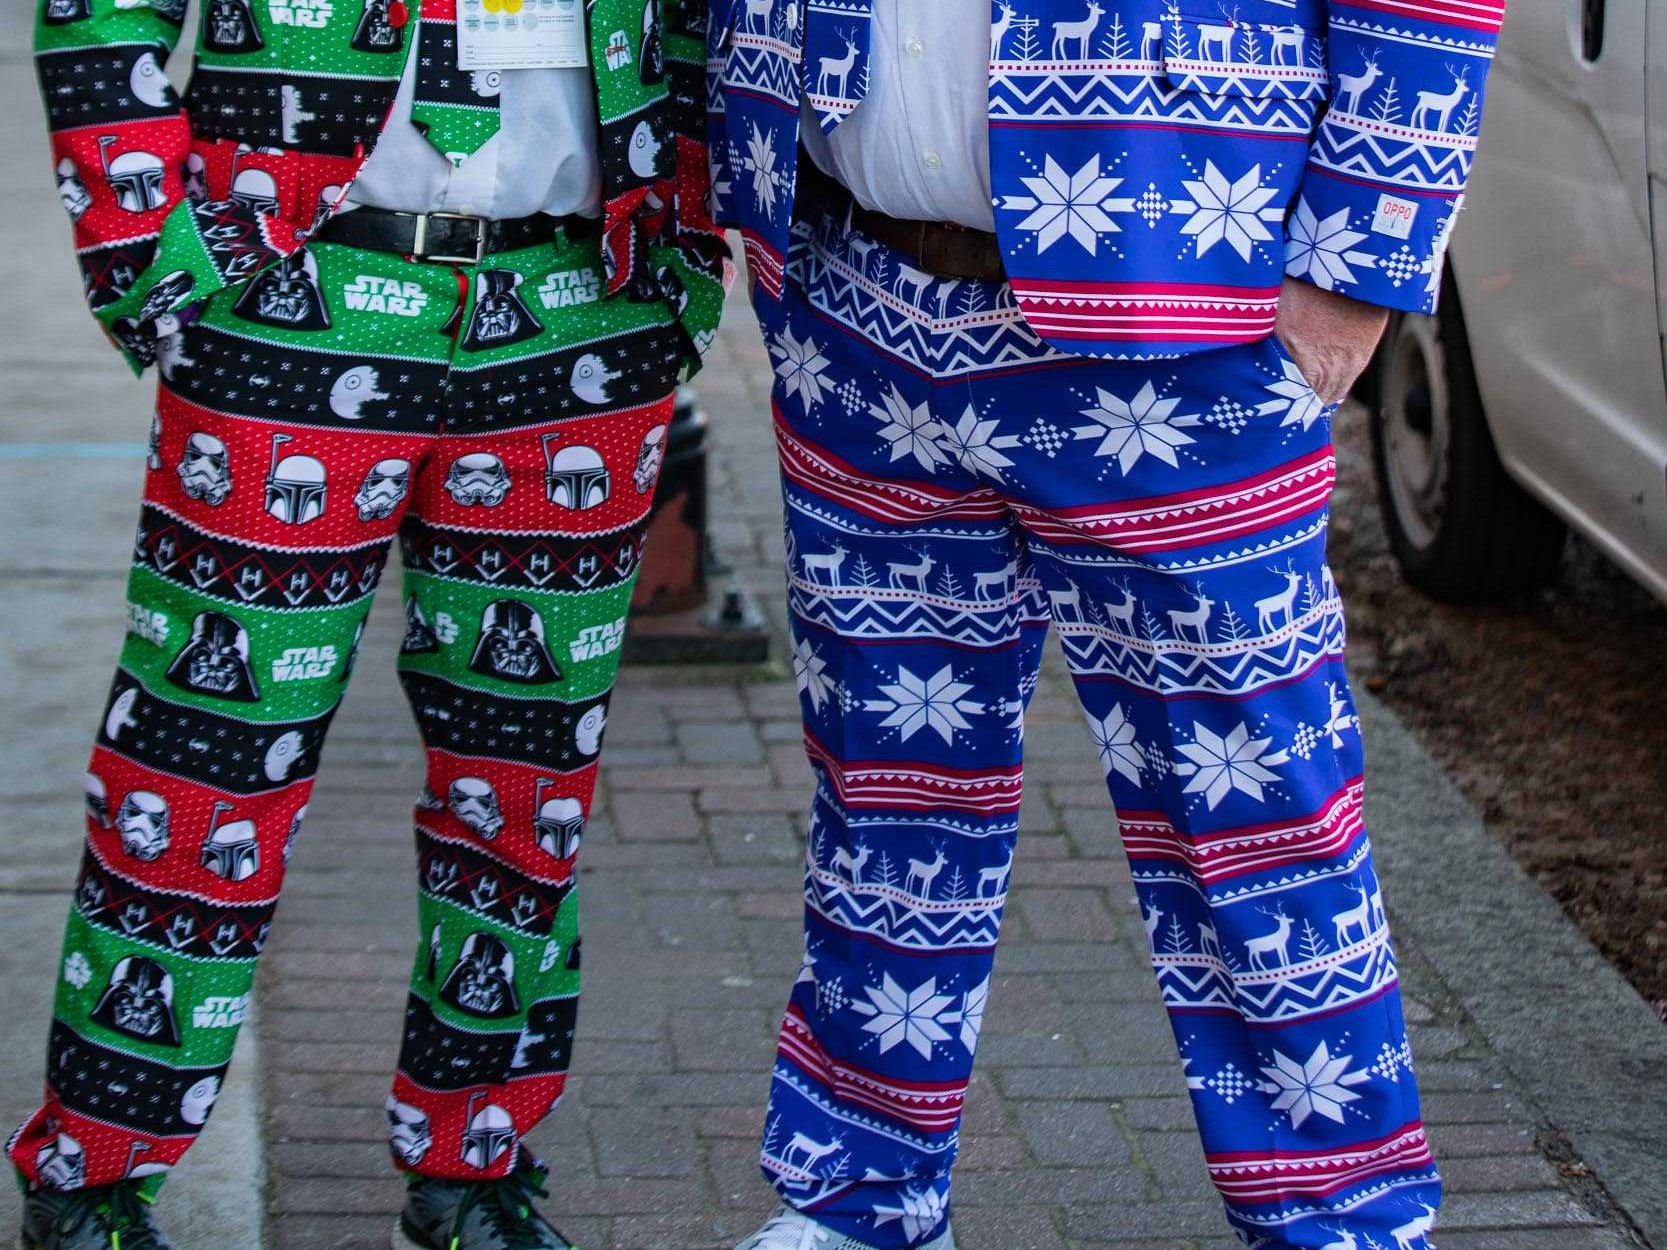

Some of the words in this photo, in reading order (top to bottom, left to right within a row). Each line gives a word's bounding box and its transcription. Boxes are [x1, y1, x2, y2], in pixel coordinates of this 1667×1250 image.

[1384, 202, 1411, 219] OPPO
[344, 275, 428, 300] STAR
[538, 267, 599, 292] STAR
[344, 291, 428, 317] WARS
[539, 284, 600, 310] WARS
[272, 645, 338, 666] STAR
[272, 661, 336, 683] WARS
